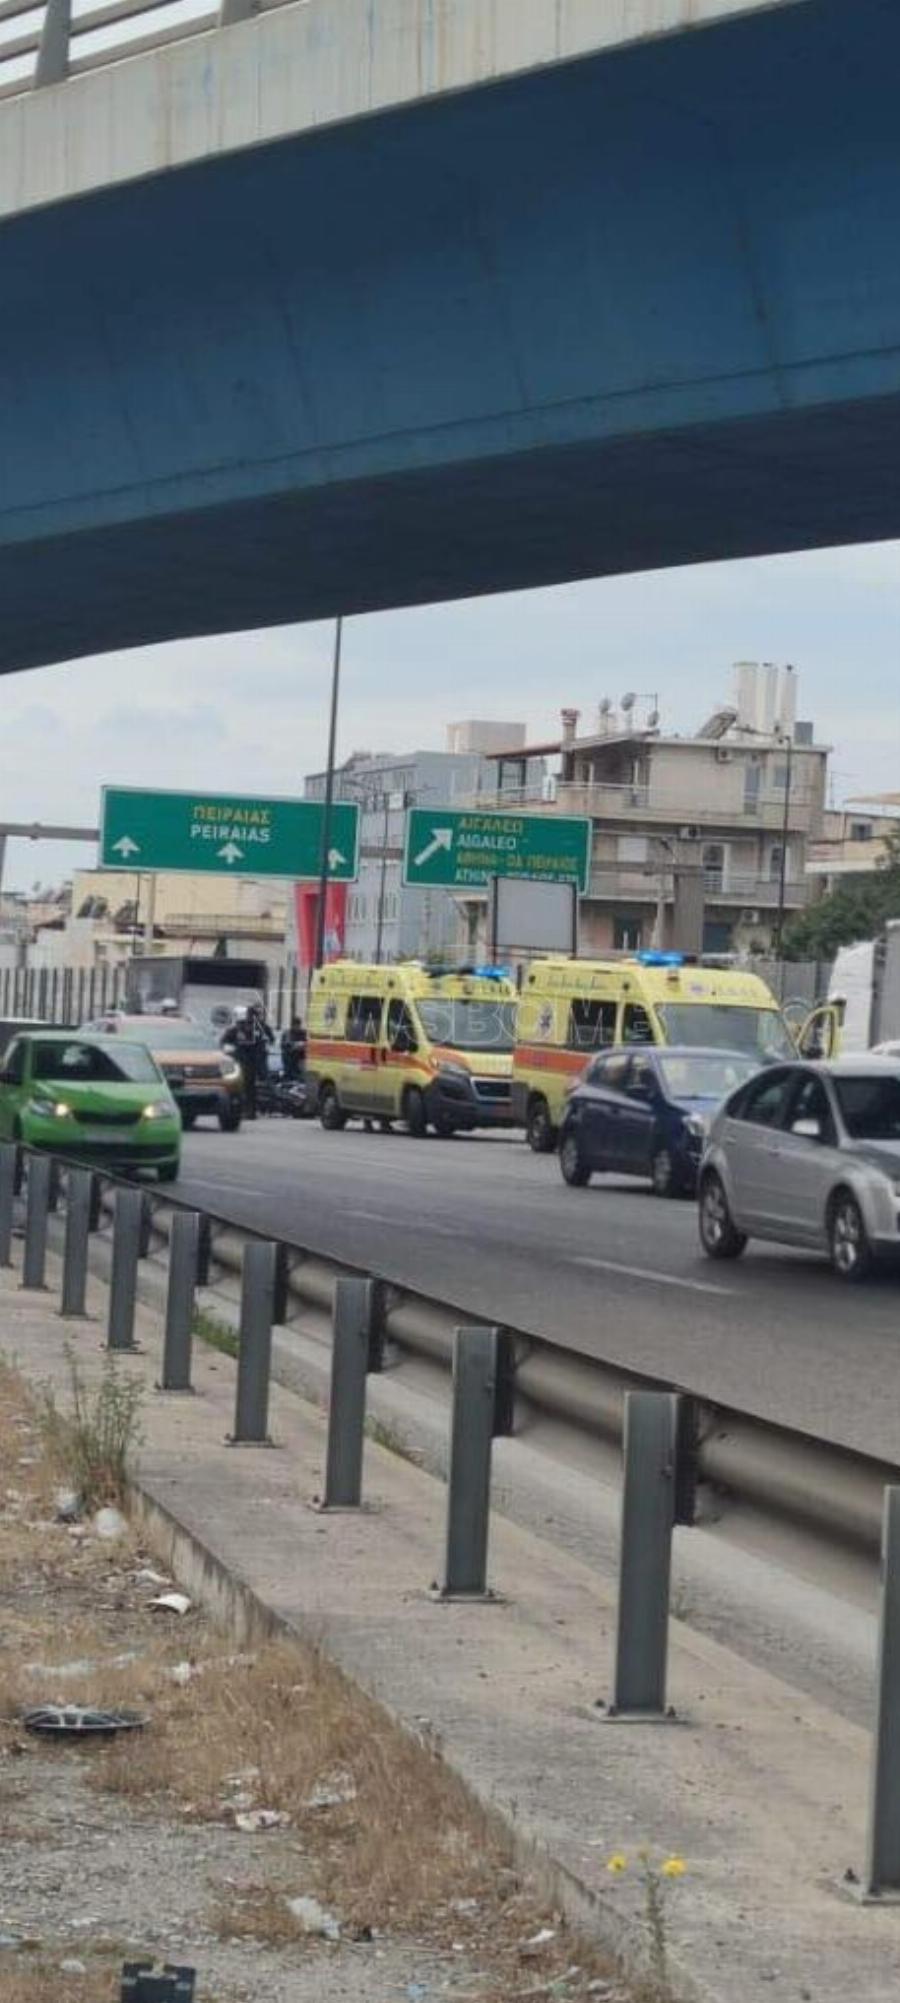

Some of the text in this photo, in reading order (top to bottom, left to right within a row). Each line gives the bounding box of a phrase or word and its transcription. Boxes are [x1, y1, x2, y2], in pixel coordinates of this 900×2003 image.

[193, 806, 270, 825] ΠΕΙΡΑΙΑΣ
[190, 824, 271, 843] PEIRAIAS
[456, 834, 517, 849] AIGALEO
